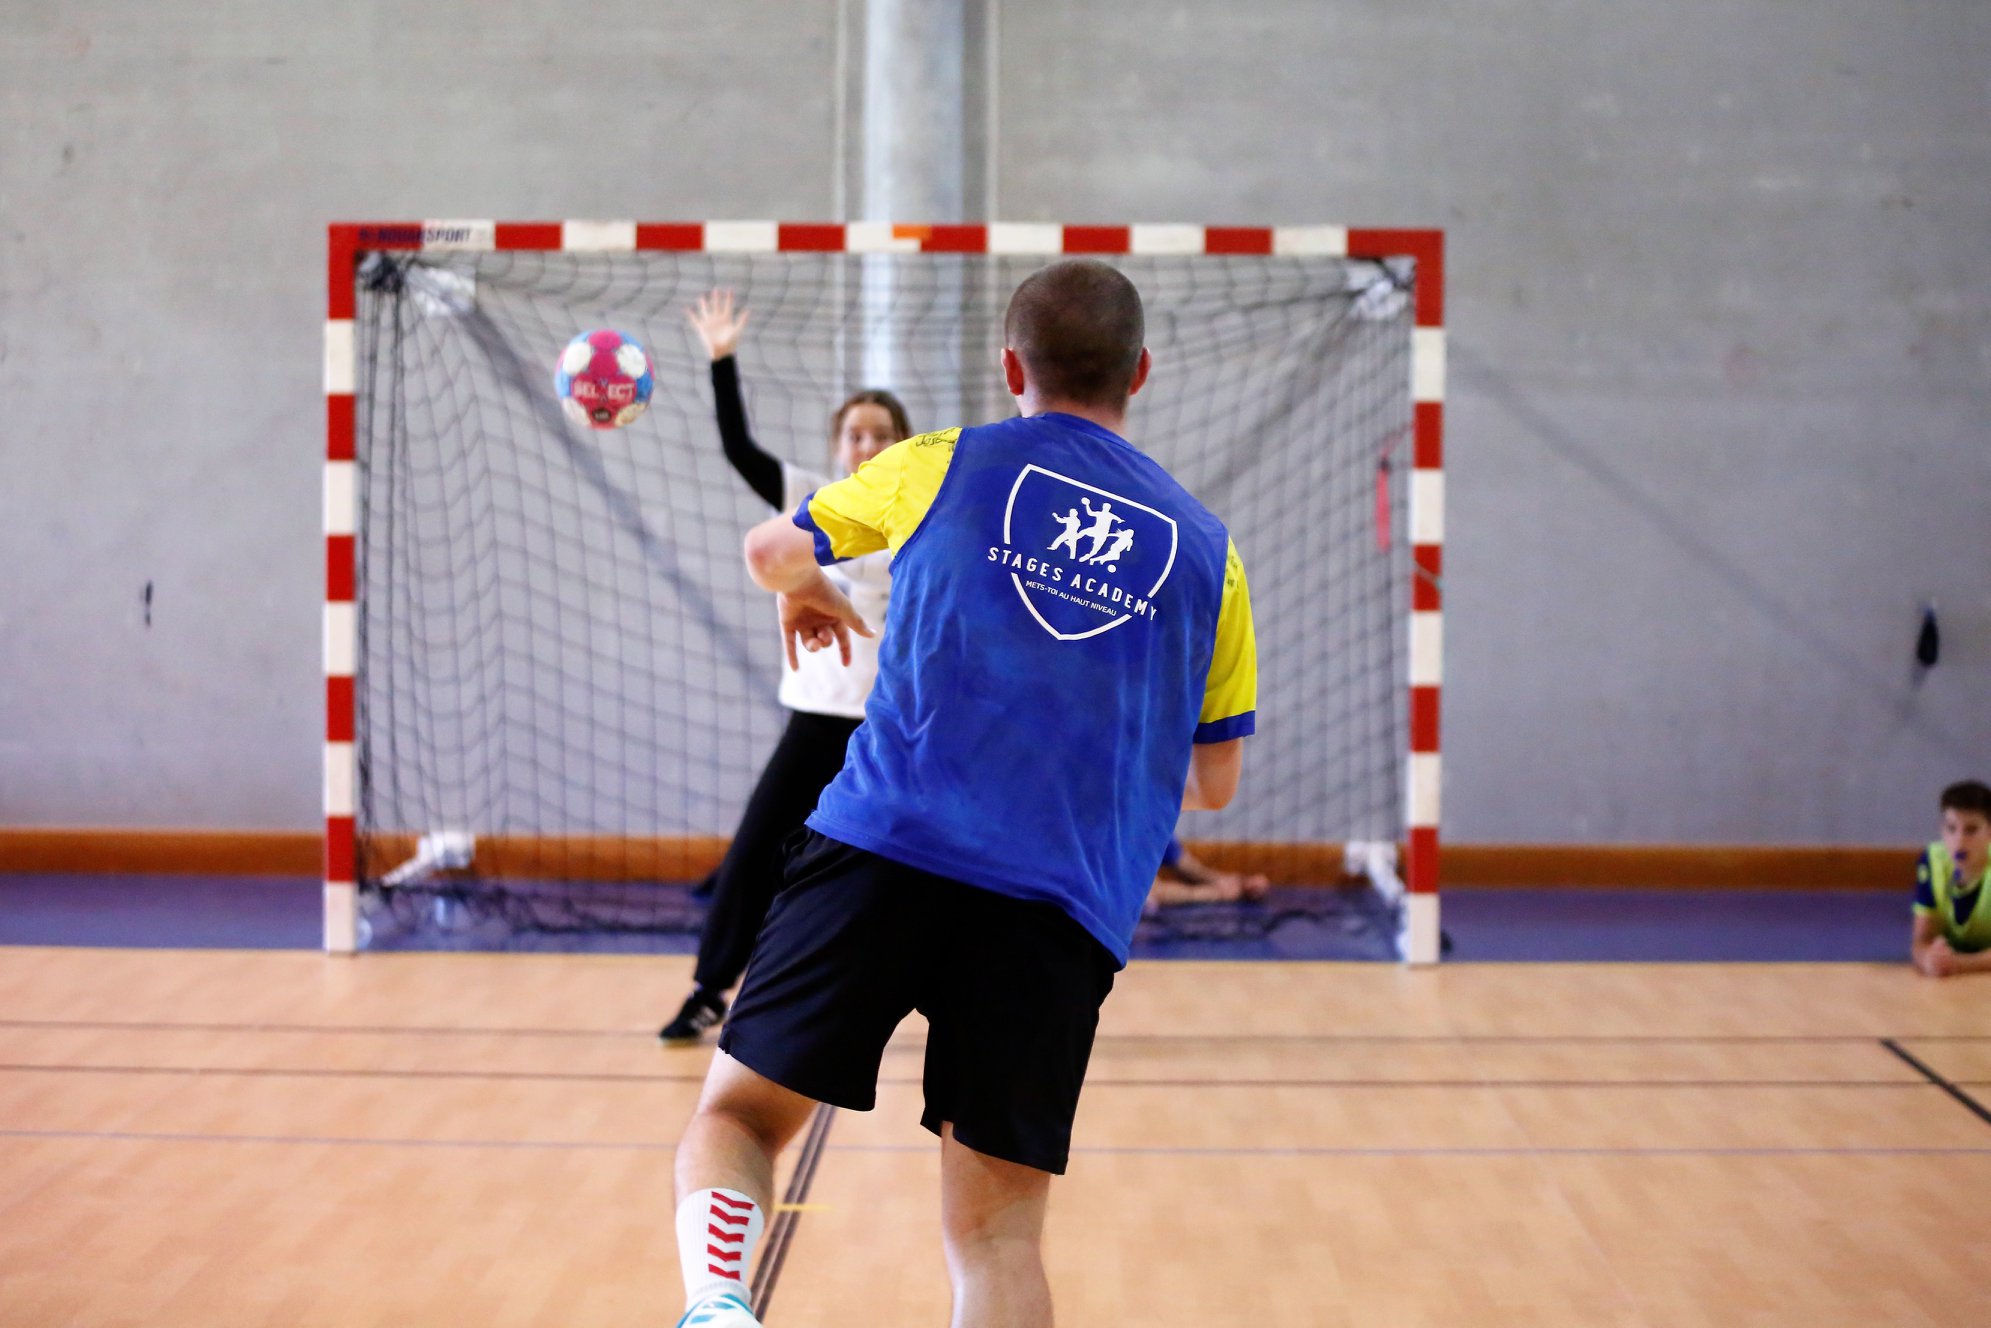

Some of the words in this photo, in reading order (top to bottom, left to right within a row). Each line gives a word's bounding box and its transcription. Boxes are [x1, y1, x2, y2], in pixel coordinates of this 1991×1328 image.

[988, 547, 1064, 582] STAGES
[1070, 574, 1157, 620] ACADEMY
[1026, 580, 1058, 596] METS-TOI
[1059, 590, 1070, 600] AU
[1070, 595, 1090, 607] HAUT
[1090, 602, 1117, 616] NIVEAU
